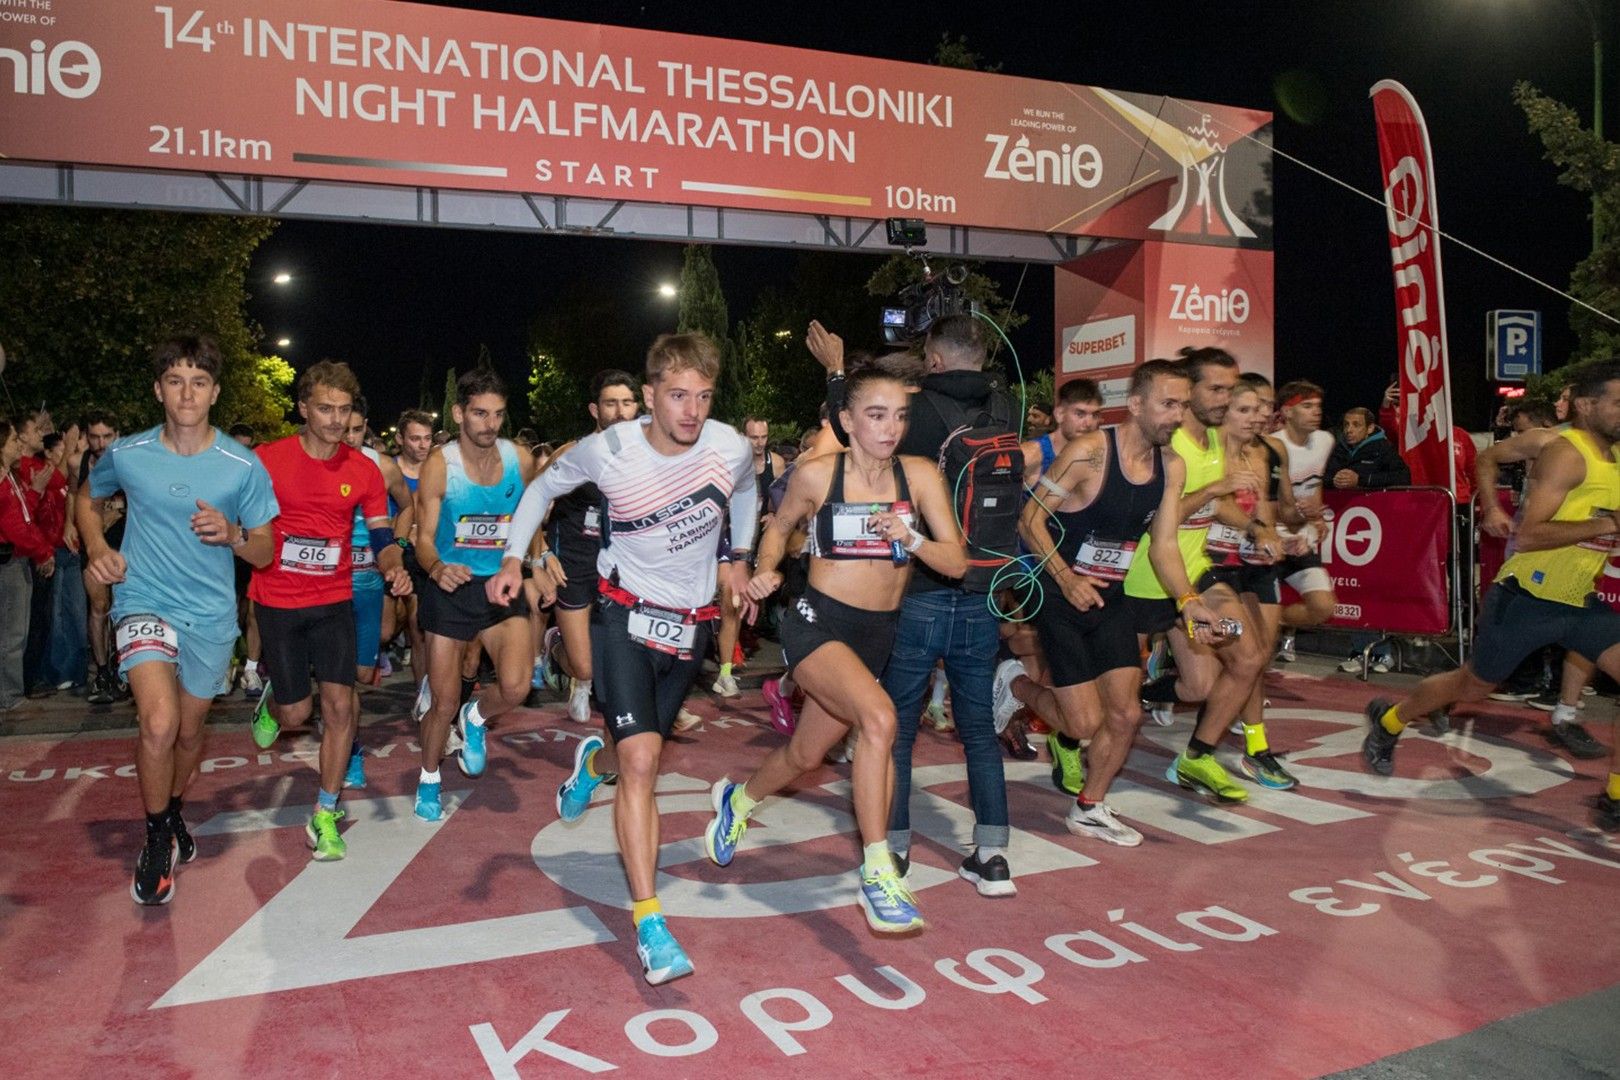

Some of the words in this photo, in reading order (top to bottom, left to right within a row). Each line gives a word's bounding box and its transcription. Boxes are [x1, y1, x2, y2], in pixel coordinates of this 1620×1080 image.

[31, 0, 52, 10] THE
[0, 12, 37, 24] OWER
[40, 16, 57, 26] OF
[243, 17, 646, 94] INTERNATIONAL
[657, 60, 953, 128] THESSALONIKI
[296, 77, 456, 128] NIGHT
[473, 93, 857, 164] HALFMARATHON
[1023, 108, 1034, 116] WE
[1036, 109, 1051, 118] RUN
[1052, 111, 1065, 121] THE
[1010, 118, 1041, 129] LEADING
[1042, 121, 1066, 132] POWER
[1067, 125, 1077, 133] OF
[148, 124, 272, 161] 21.1km
[534, 158, 660, 189] START
[885, 184, 957, 214] 10km
[1068, 332, 1126, 356] SUPERBET
[1506, 327, 1528, 356] P
[471, 523, 498, 536] 109
[631, 516, 655, 530] LA
[299, 547, 326, 562] 616
[1092, 549, 1122, 564] 822
[127, 622, 165, 639] 568
[647, 618, 684, 643] 102
